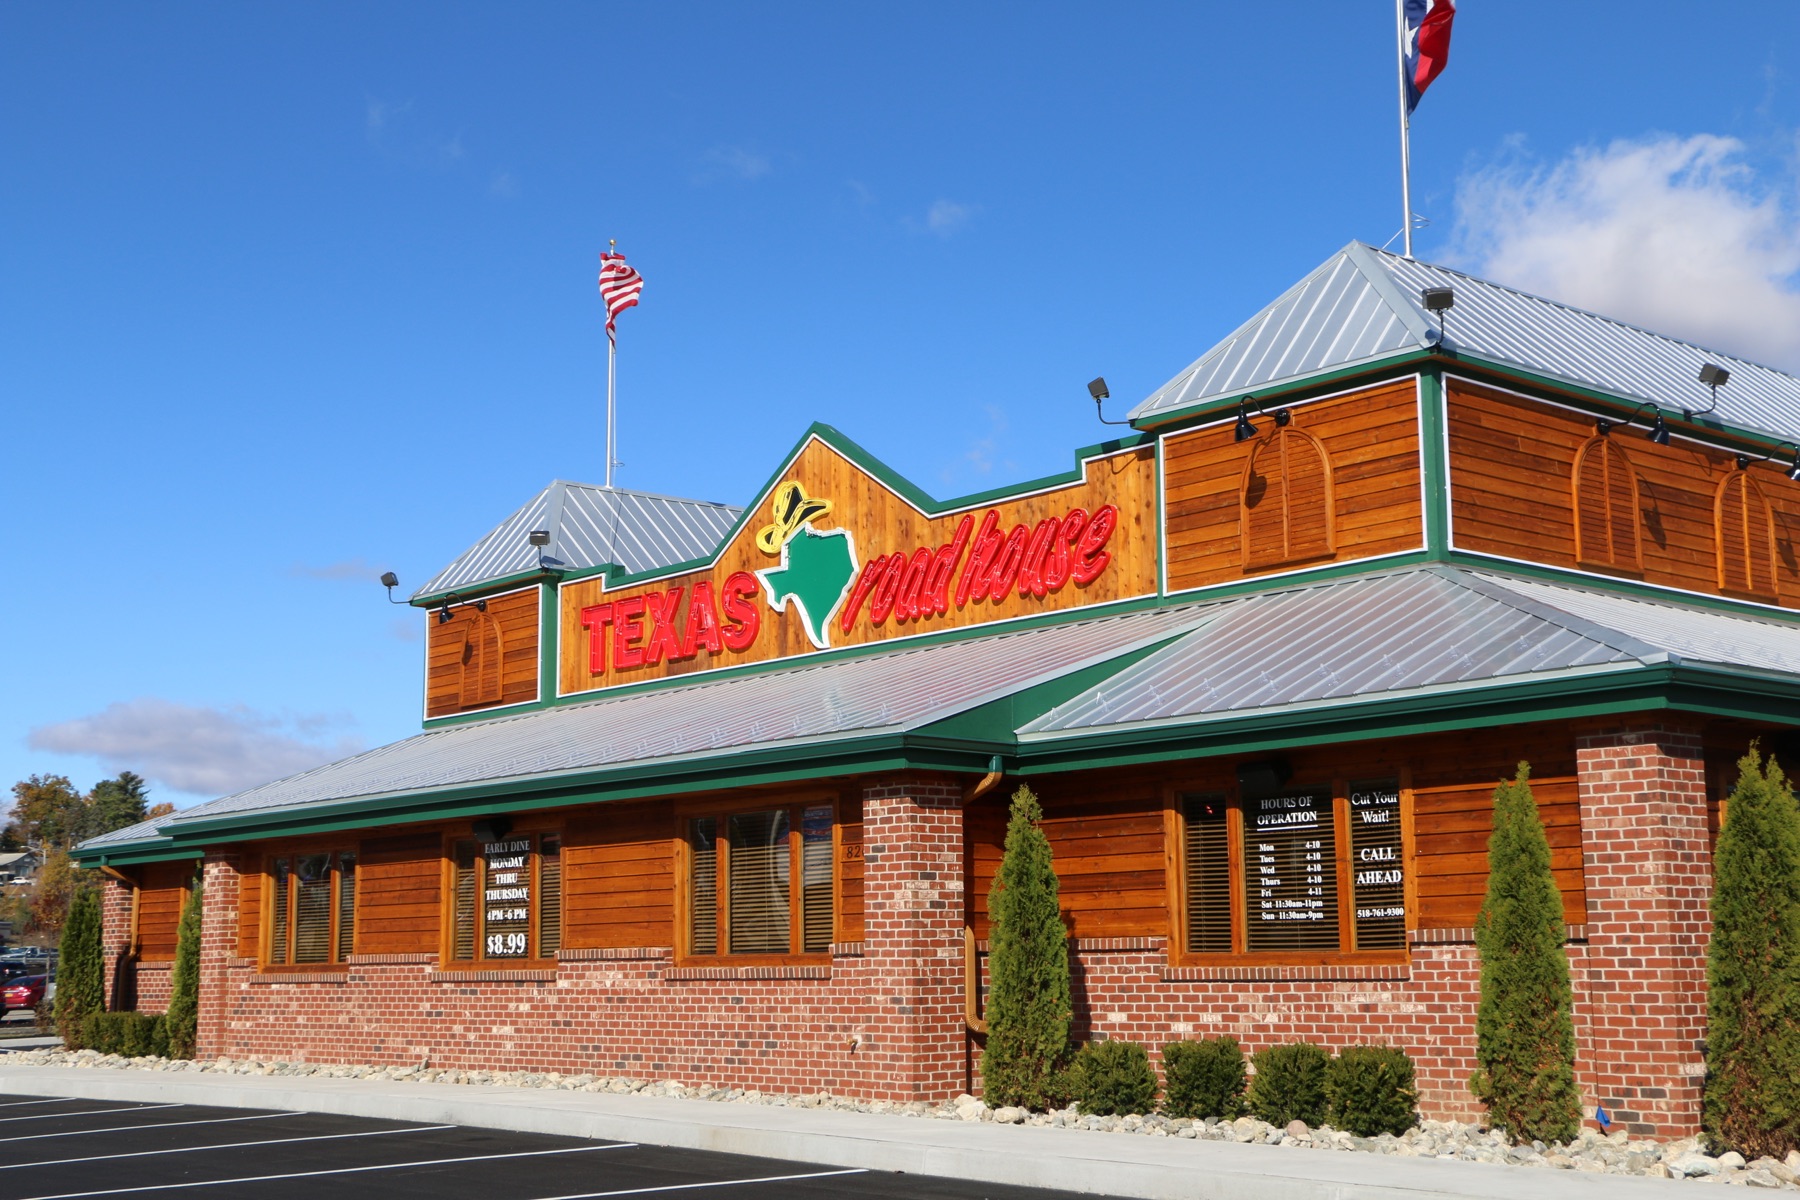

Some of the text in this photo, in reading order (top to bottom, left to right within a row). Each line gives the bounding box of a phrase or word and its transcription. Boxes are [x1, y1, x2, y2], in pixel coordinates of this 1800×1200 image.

[581, 571, 759, 676] TEXAS
[1261, 796, 1313, 809] HOURS OF
[1352, 792, 1397, 806] Cut Your
[1257, 811, 1317, 825] OPERATION
[1361, 810, 1389, 823] Wait!
[485, 840, 530, 854] EARLY DINE
[1305, 841, 1320, 849] 4-10
[847, 845, 864, 859] 82
[1260, 852, 1321, 863] Tues 4-10
[1361, 847, 1395, 861] CALL
[490, 857, 523, 869] MONDAY
[1260, 864, 1321, 874] Wed 4-10
[495, 873, 517, 884] THRU
[1357, 870, 1401, 884] AHEAD
[486, 888, 528, 900] THURSDAY
[1261, 889, 1271, 897] Fri
[1275, 900, 1323, 909] 11:30am-11pm
[1262, 911, 1323, 920] Sun 11:30am-9pm
[1357, 908, 1404, 918] 518-761-9300
[487, 933, 525, 954] $8.99
